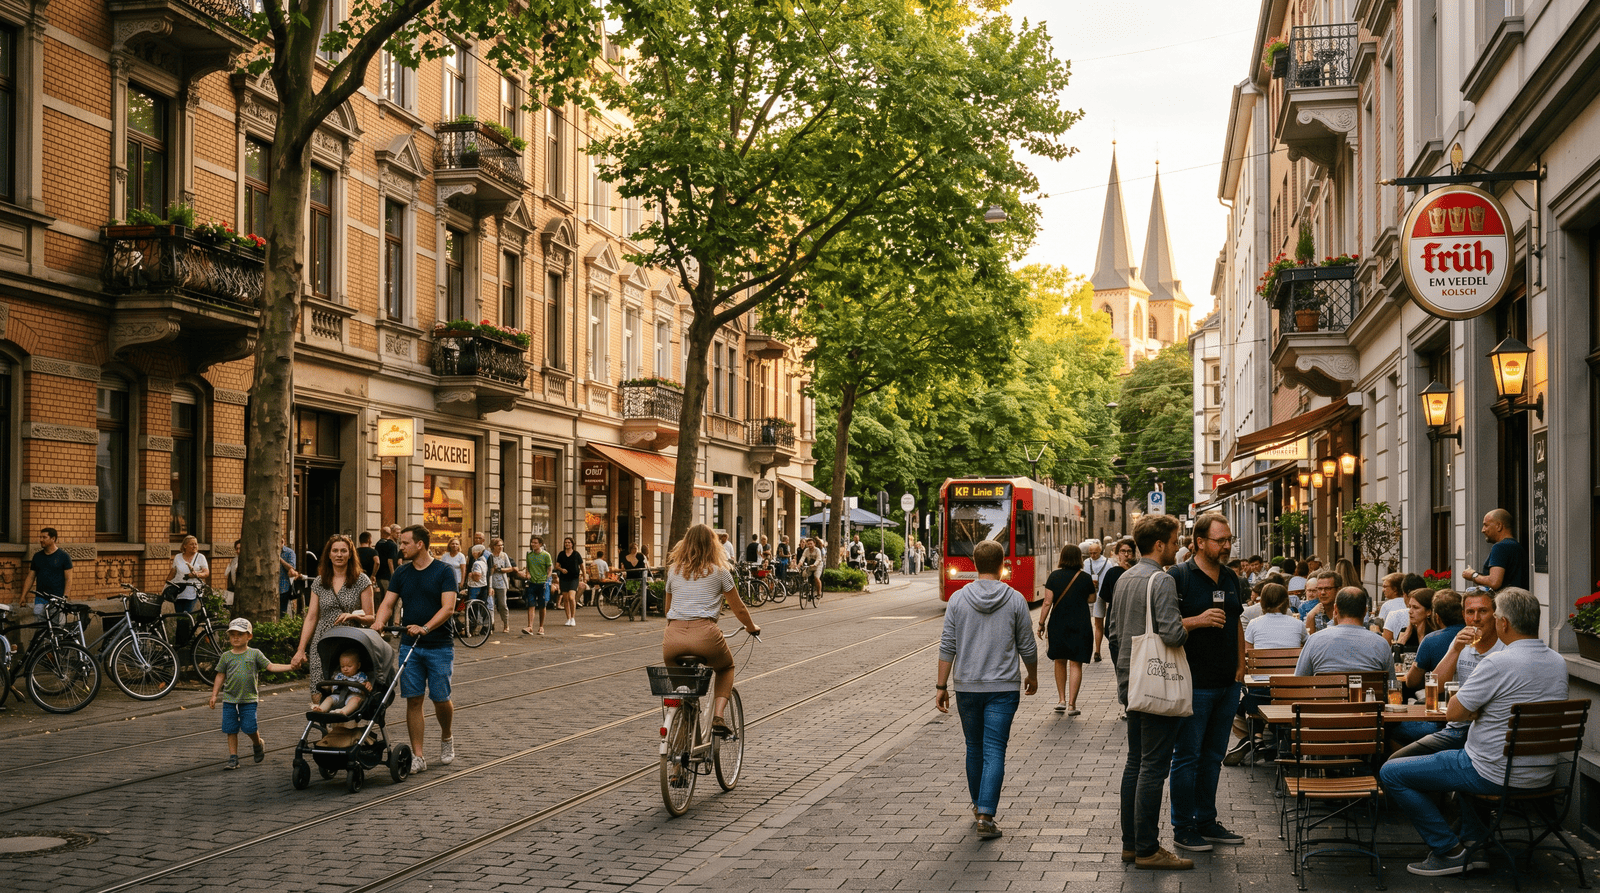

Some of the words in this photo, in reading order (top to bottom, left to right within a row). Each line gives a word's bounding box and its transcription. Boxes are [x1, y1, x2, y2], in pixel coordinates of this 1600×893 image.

[1429, 278, 1446, 287] EM
[1448, 277, 1489, 286] VEEDEL
[424, 440, 471, 464] BÄCKEREI
[972, 487, 993, 496] Linie
